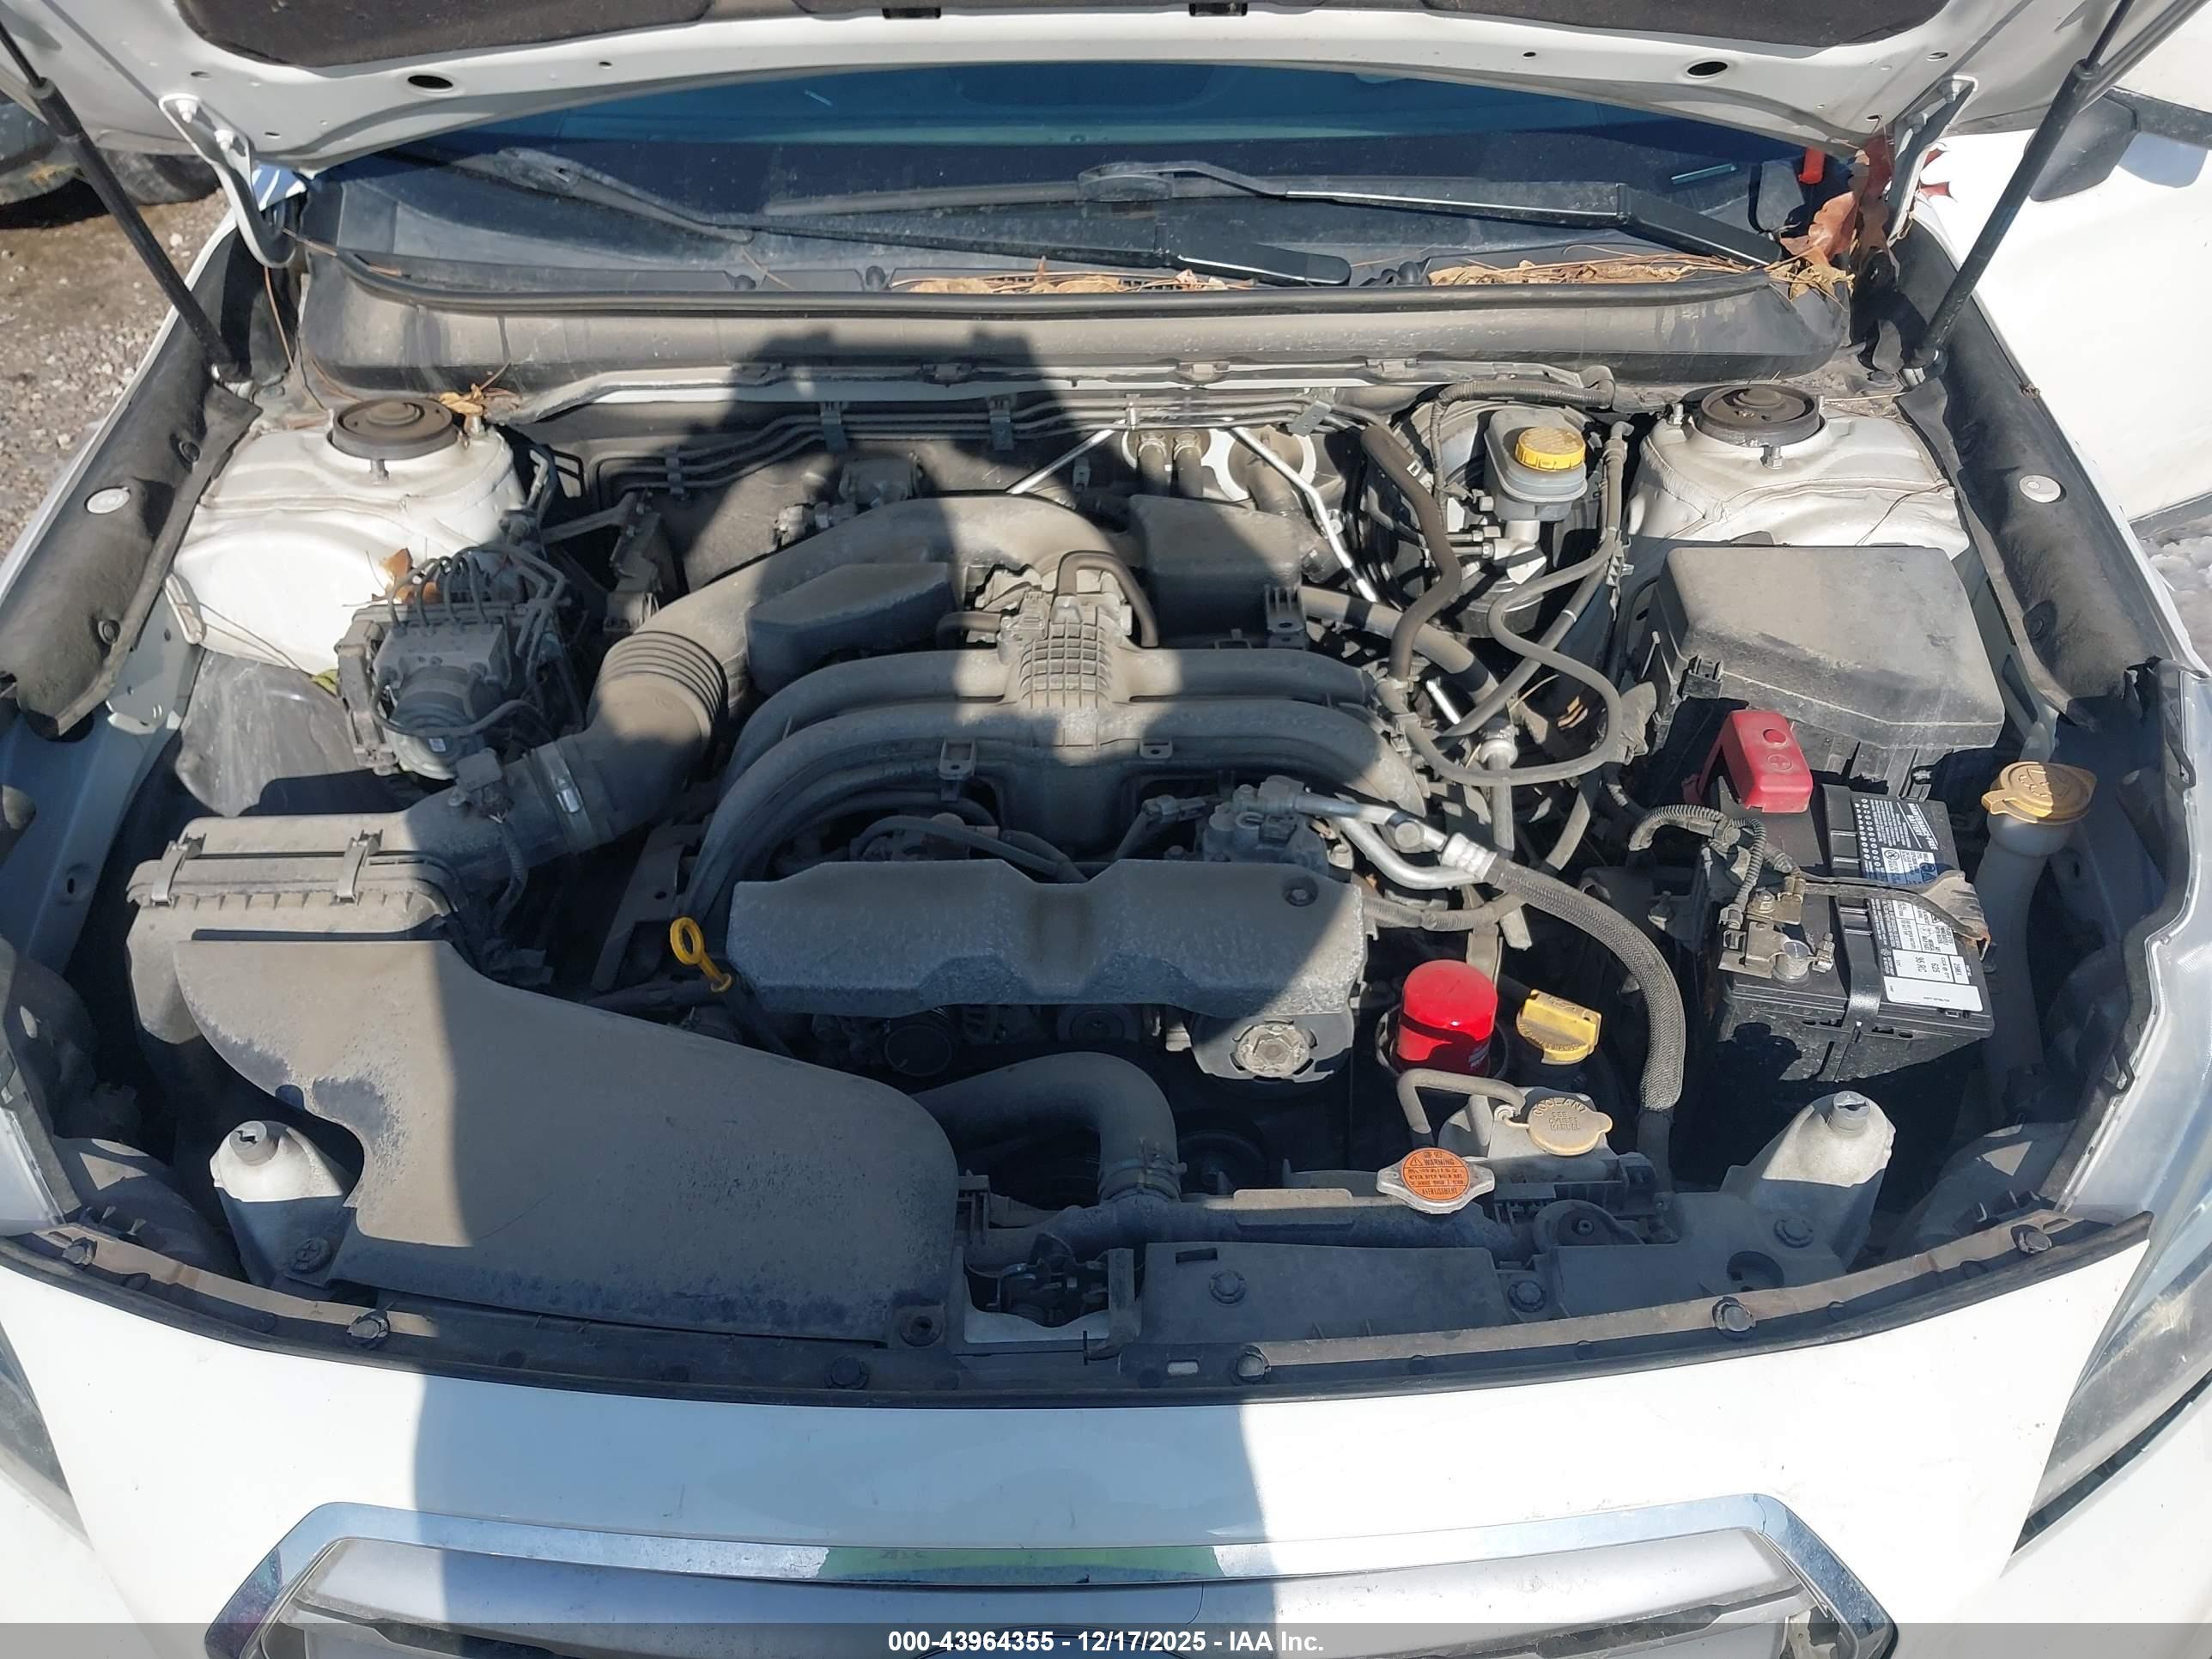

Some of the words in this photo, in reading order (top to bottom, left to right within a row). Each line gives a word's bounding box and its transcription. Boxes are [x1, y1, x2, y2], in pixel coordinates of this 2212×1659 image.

[1906, 815, 1923, 836] BATTERY
[1917, 963, 1926, 972] RC
[1930, 963, 1940, 973] 625
[1533, 1097, 1587, 1116] COOLANT
